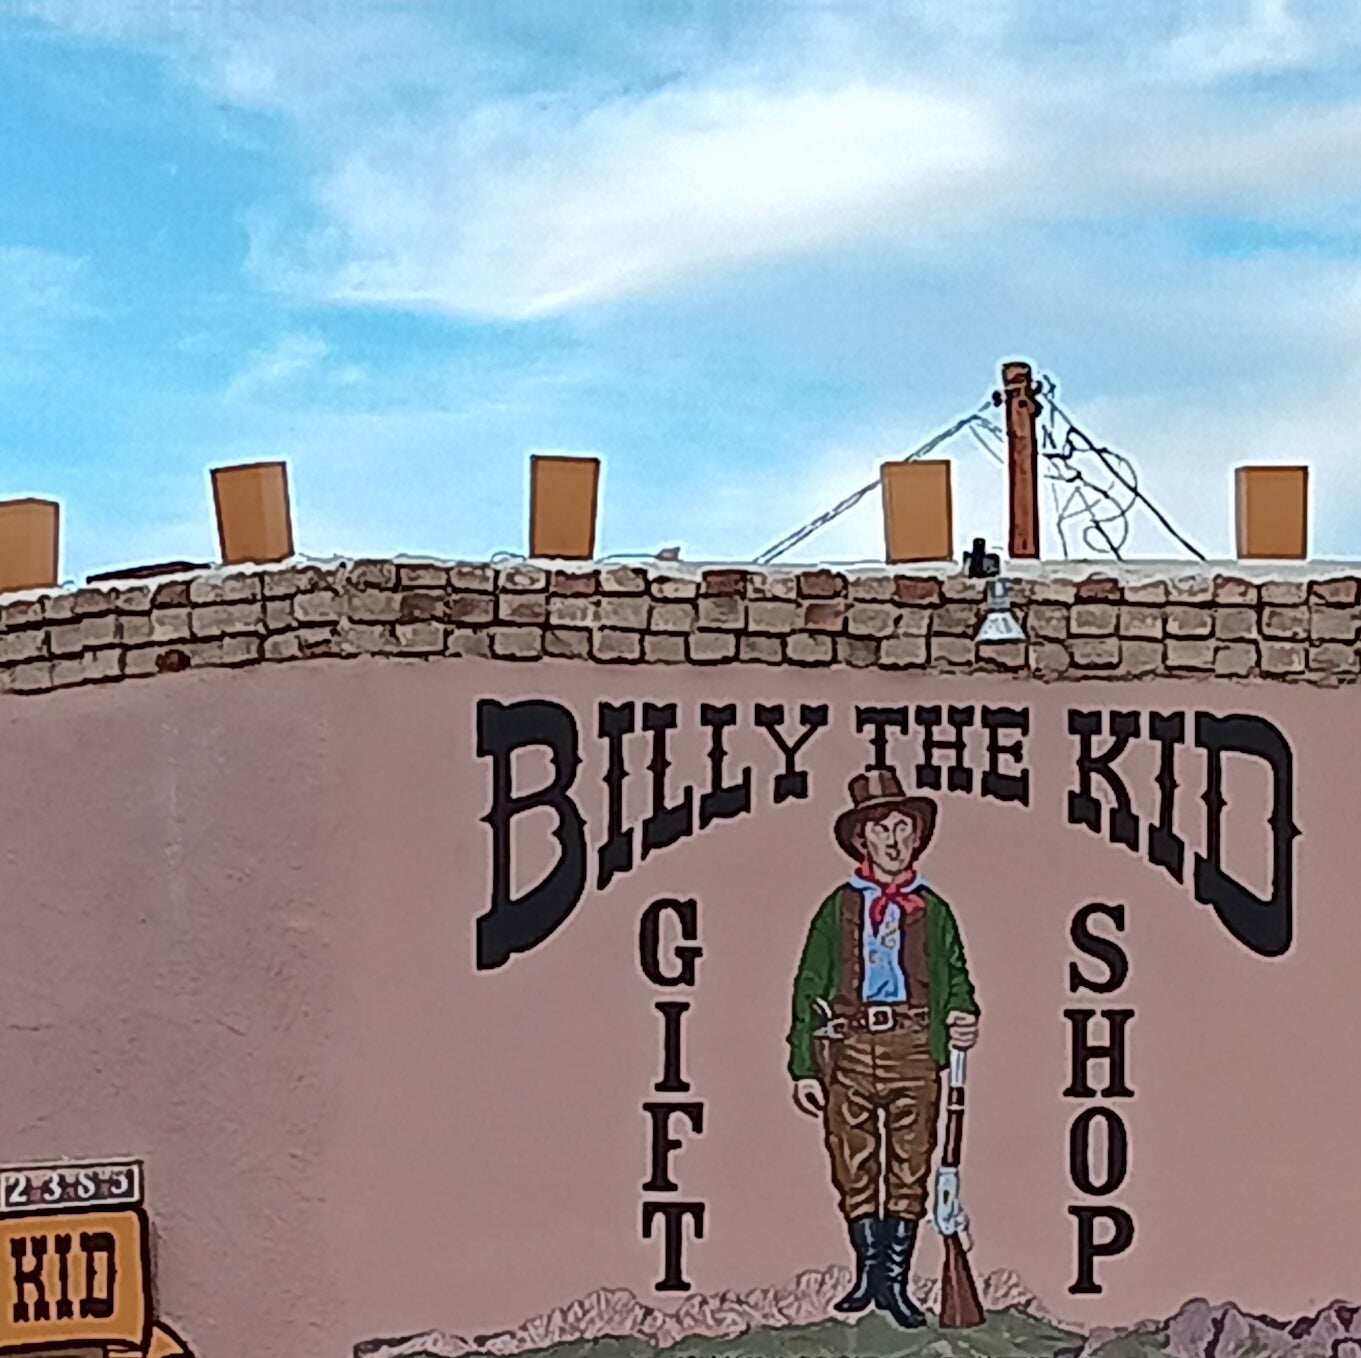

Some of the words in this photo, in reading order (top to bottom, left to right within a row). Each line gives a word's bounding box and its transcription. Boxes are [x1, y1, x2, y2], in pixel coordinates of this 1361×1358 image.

[475, 698, 828, 970] BILLY
[854, 705, 1030, 806] THE
[1067, 709, 1302, 957] KID
[6, 1169, 129, 1203] 2385
[640, 898, 705, 1291] GIFT
[1064, 903, 1135, 1294] SHOP
[10, 1231, 117, 1322] KID
